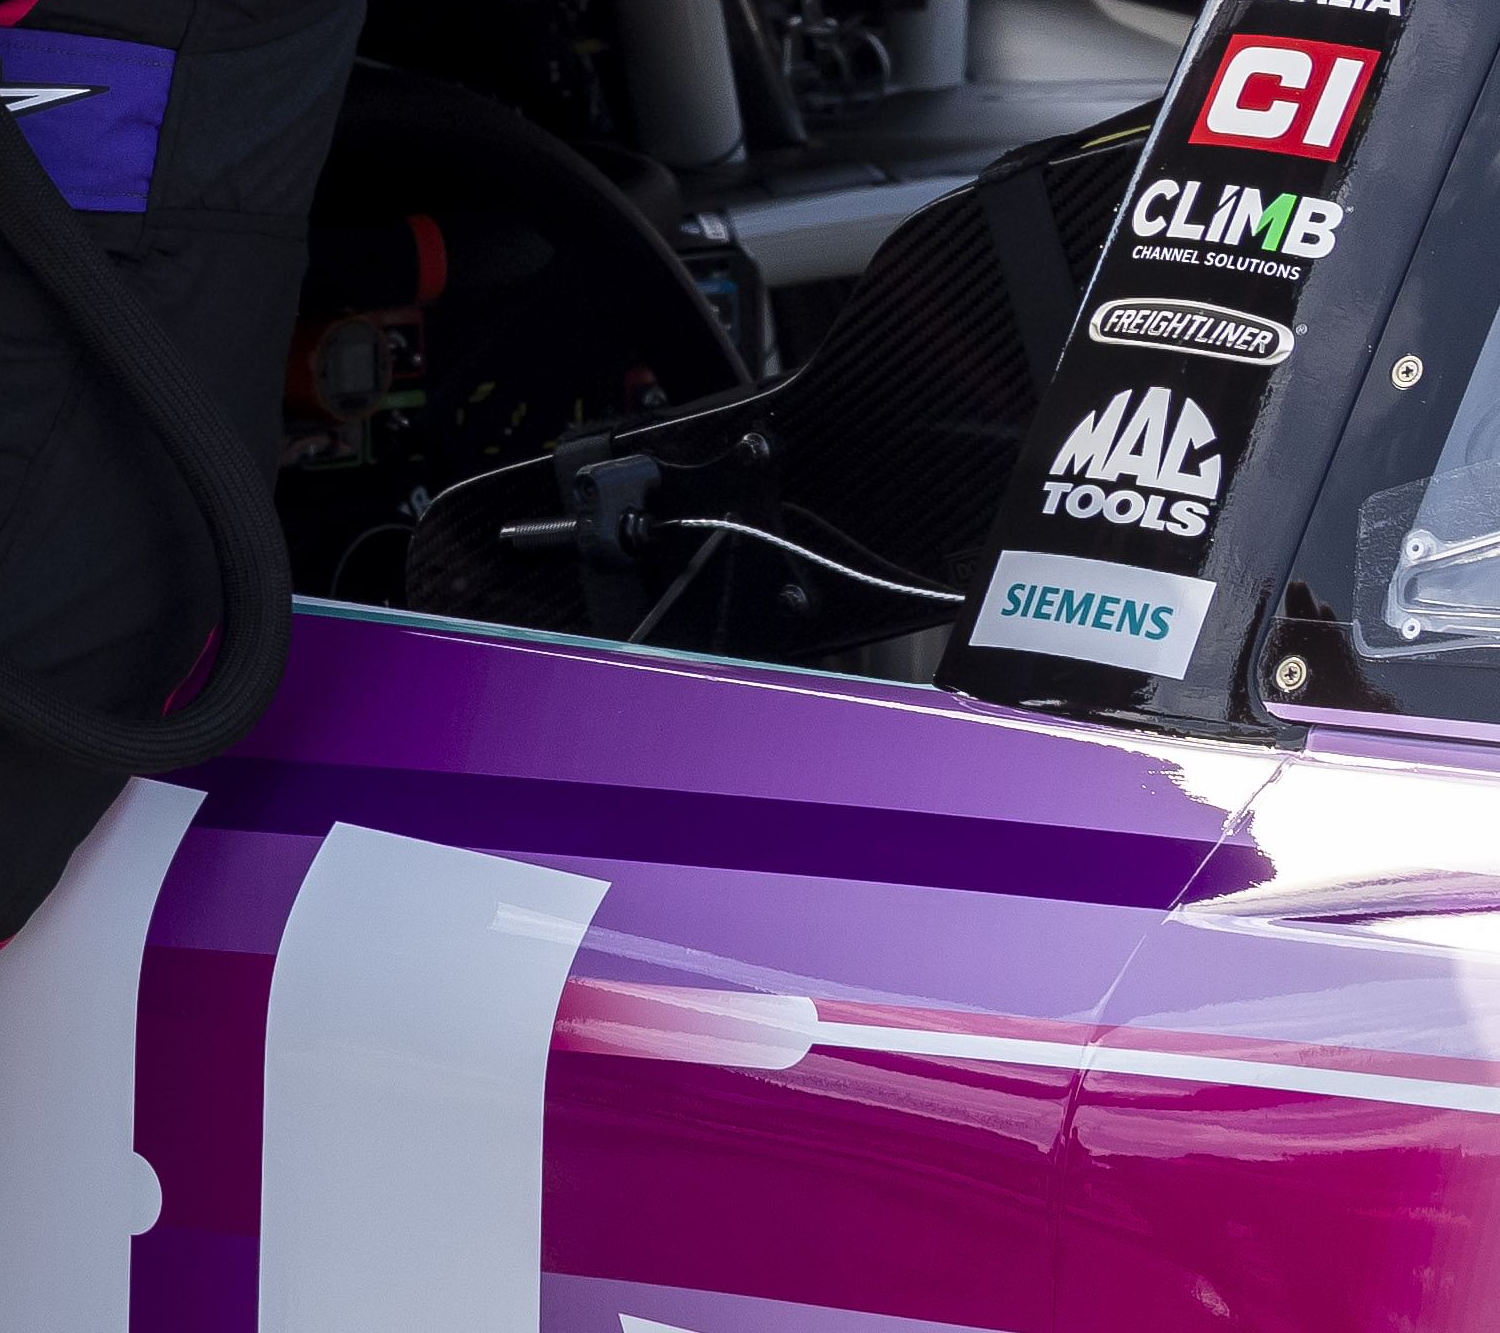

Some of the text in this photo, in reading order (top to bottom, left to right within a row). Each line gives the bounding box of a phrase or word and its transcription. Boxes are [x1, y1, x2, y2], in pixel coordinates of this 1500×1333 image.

[1206, 45, 1365, 149] CI
[1132, 179, 1345, 259] CLIMB
[1132, 245, 1301, 282] CHANNEL SOLUTIONS
[1104, 307, 1274, 354] FREIGHTLINER
[1049, 386, 1222, 500] MAC
[1042, 481, 1210, 538] TOOLS
[1000, 581, 1174, 642] SIEMENS
